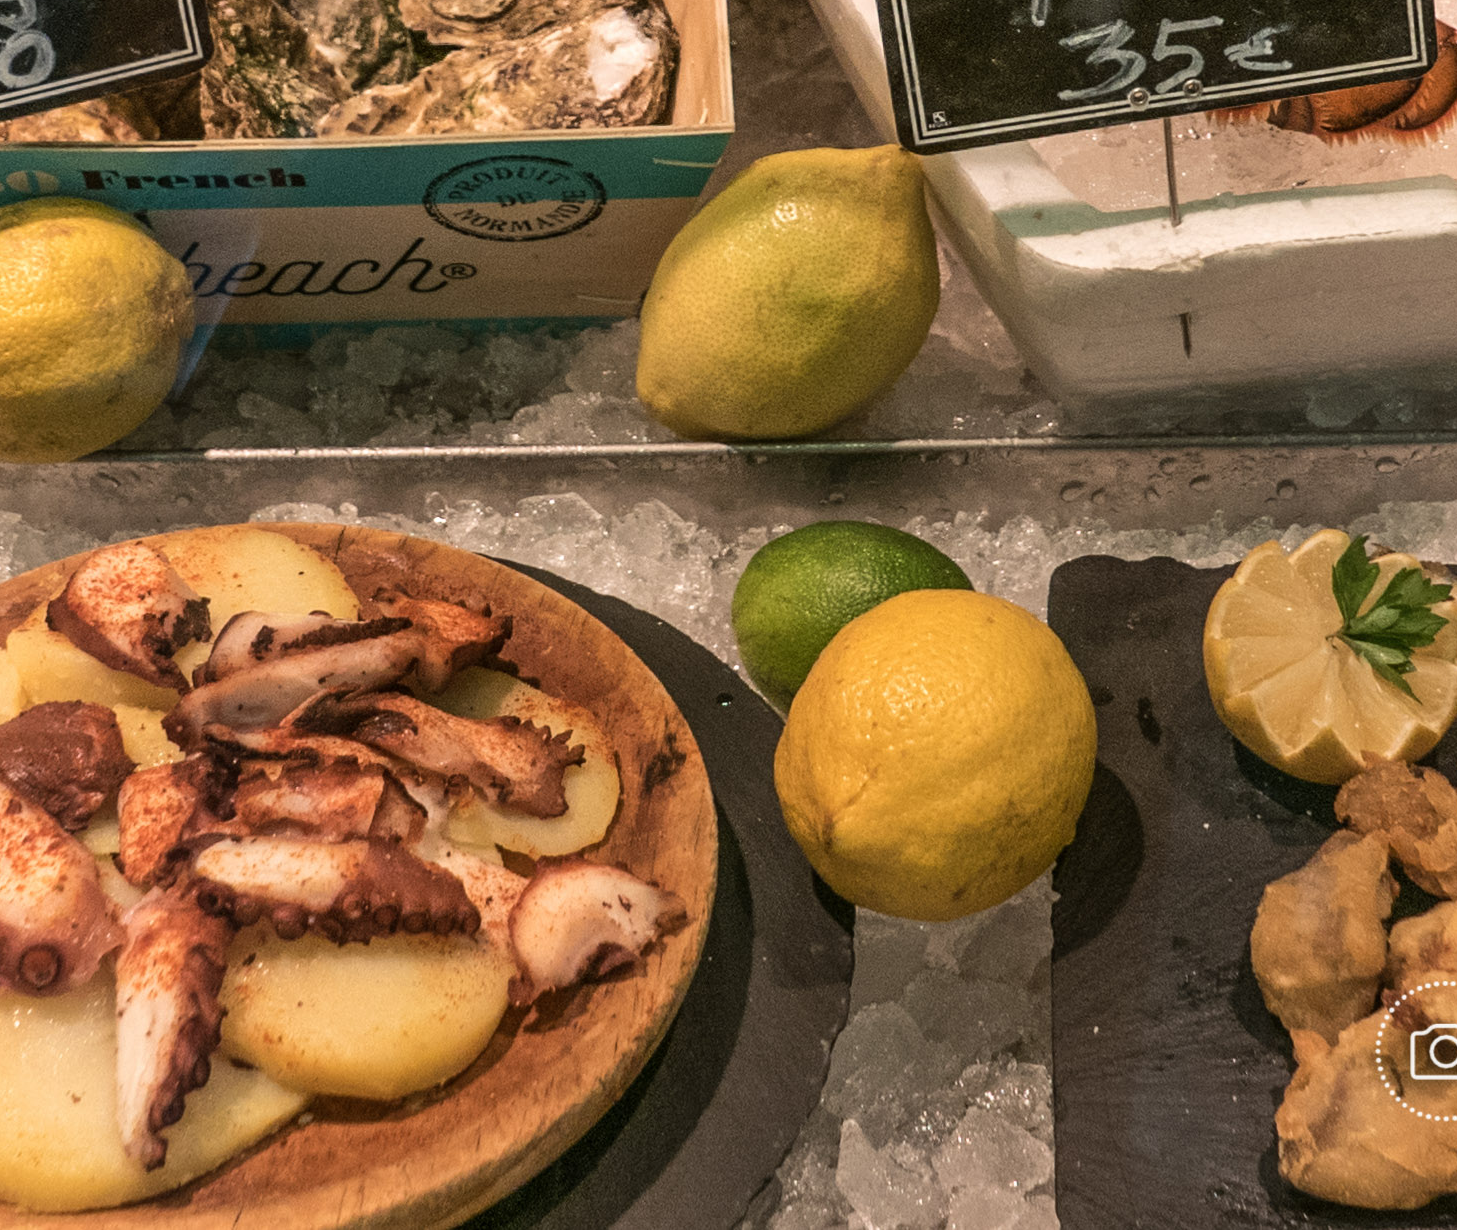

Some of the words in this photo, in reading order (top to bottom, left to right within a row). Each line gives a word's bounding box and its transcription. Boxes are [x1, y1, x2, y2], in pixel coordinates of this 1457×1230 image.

[81, 167, 306, 190] French
[448, 166, 570, 200] PRODUIT
[453, 189, 587, 233] NORMANDIE
[496, 191, 538, 208] DE
